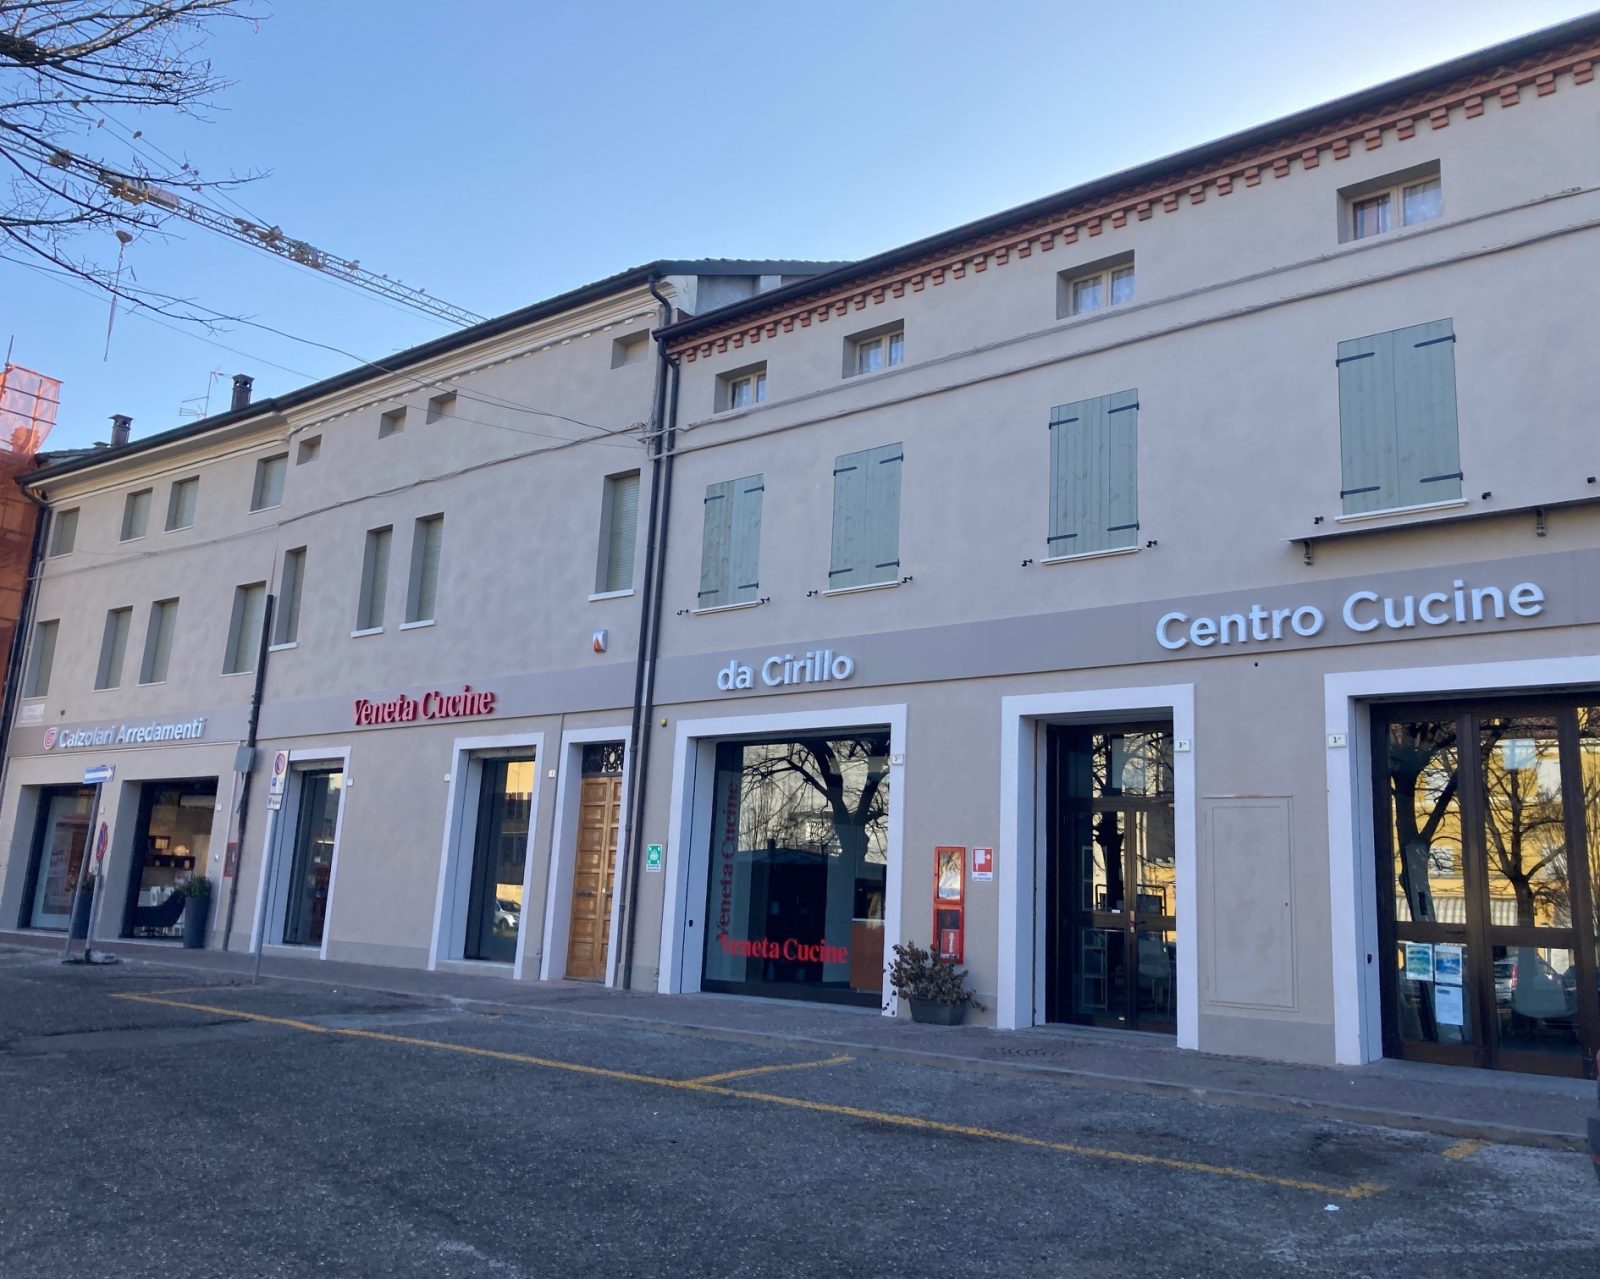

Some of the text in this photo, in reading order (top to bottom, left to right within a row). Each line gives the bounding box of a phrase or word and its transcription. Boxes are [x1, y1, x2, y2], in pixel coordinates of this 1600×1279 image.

[1155, 579, 1545, 649] Centro Cucine
[717, 649, 854, 691] da Cirillo
[353, 685, 496, 726] Veneta Cucine
[59, 717, 206, 748] Calzolari Arredamenti
[716, 784, 740, 939] Veneta Cucine
[719, 935, 848, 963] Veneta Cucine
